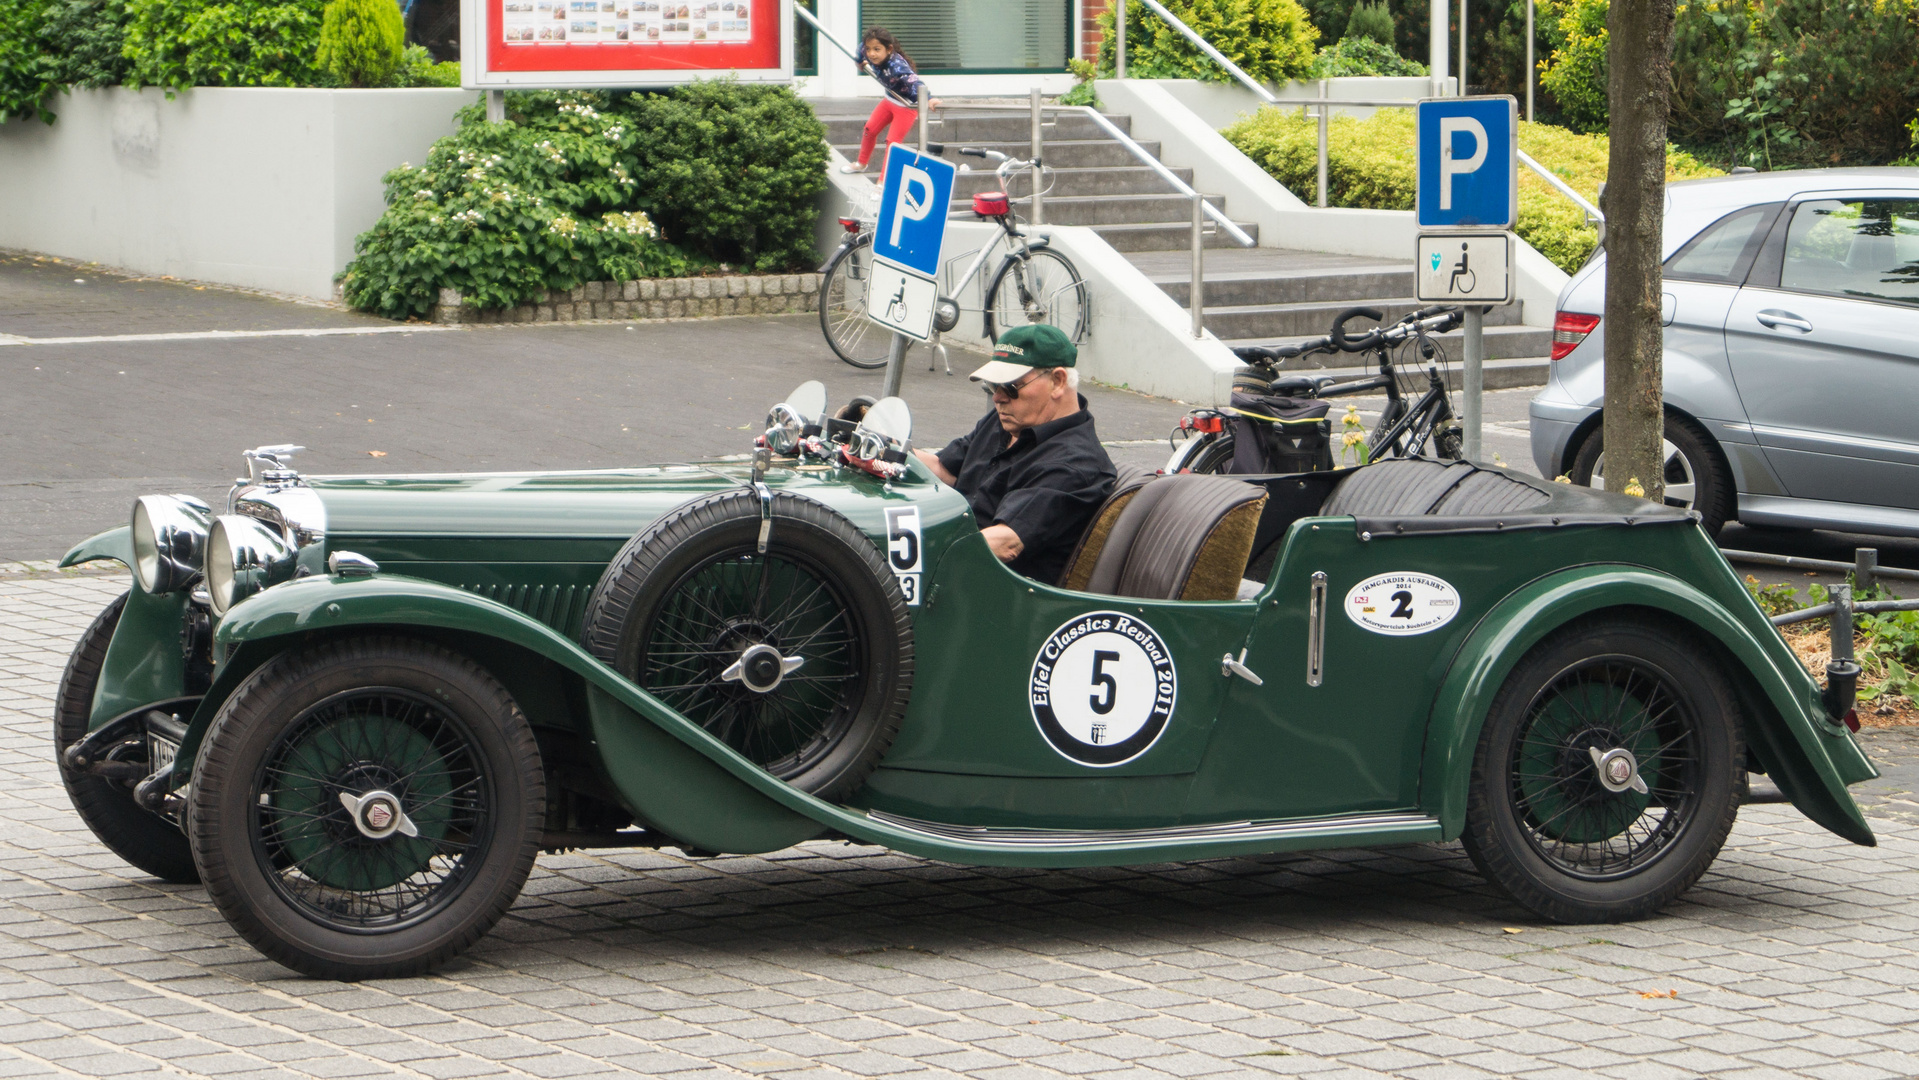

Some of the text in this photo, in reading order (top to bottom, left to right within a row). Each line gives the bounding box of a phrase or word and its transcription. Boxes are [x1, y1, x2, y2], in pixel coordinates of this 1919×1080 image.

[1440, 116, 1489, 210] P
[890, 164, 934, 247] P
[887, 508, 918, 571] 5
[1362, 577, 1445, 592] IRMGARDIS AUSFAHRT
[1390, 590, 1413, 620] 2
[1361, 616, 1405, 630] Motorsportclub
[1033, 617, 1174, 715] Eifel Classics Revival 2011
[1090, 650, 1120, 715] 5
